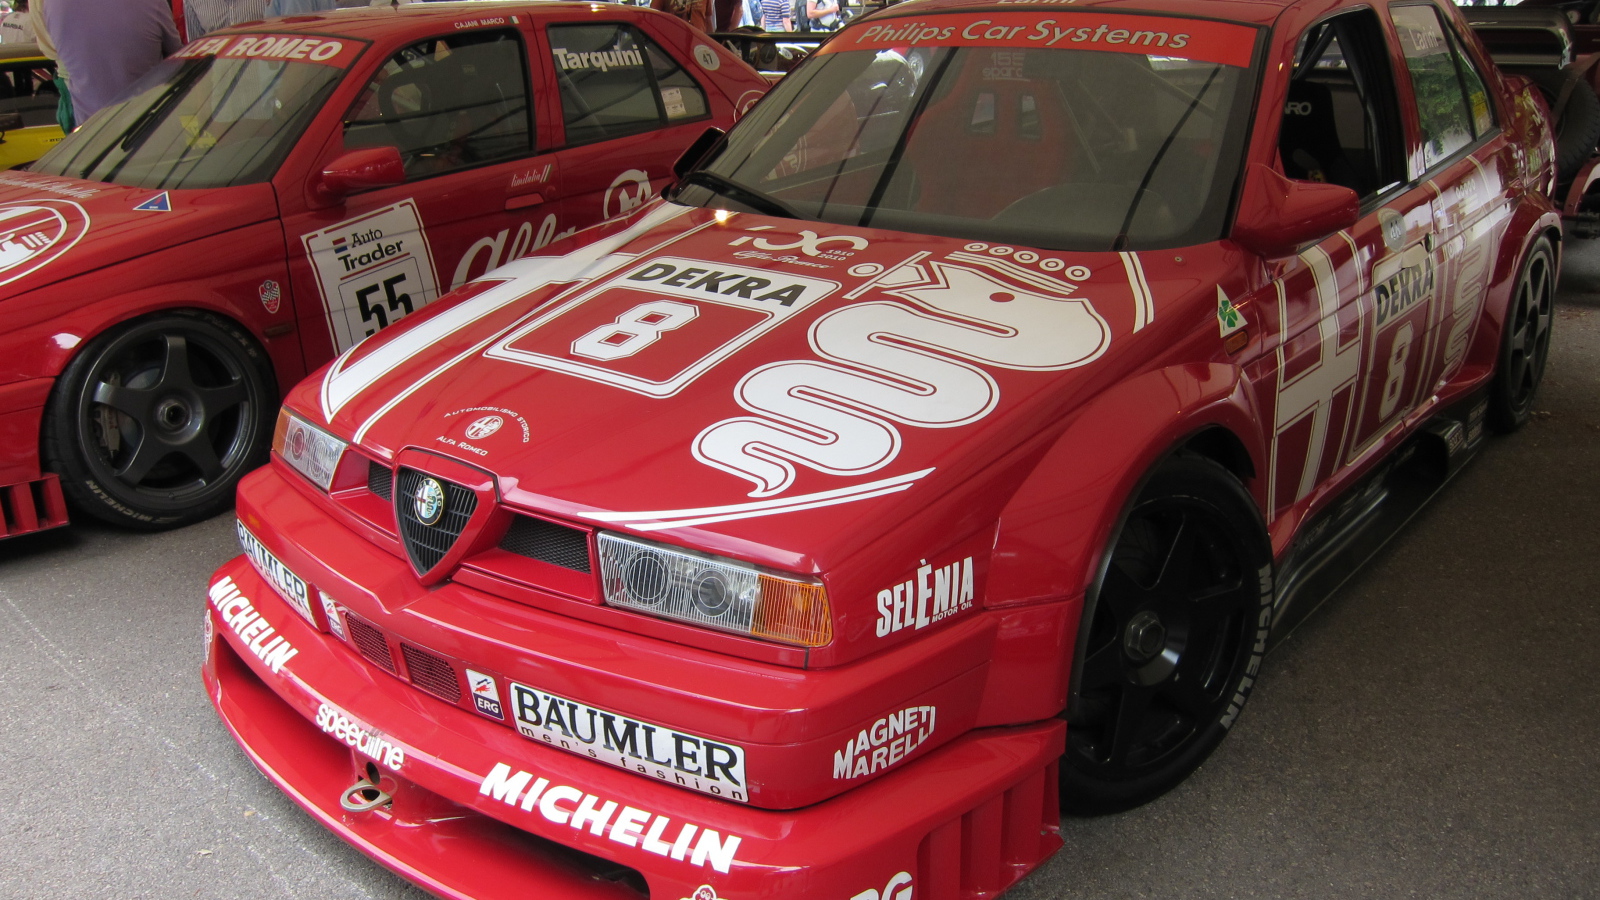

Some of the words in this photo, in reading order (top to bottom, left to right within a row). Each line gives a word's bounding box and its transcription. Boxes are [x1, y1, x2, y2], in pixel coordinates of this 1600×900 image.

[454, 20, 479, 29] CAJANI
[480, 17, 505, 26] MARCO
[856, 25, 956, 44] Philips
[961, 20, 1027, 40] Car
[1027, 20, 1192, 49] Systems
[1408, 25, 1439, 51] Larini
[174, 38, 230, 58] ALFA
[226, 37, 343, 61] ROMEO
[552, 45, 644, 72] Tarquini
[702, 54, 714, 66] 47
[338, 240, 403, 271] Trader
[351, 228, 383, 248] Auto
[817, 253, 847, 262] 2010
[626, 262, 807, 308] DEKRA
[1375, 257, 1434, 327] DEKRA
[355, 273, 414, 337] 55
[570, 300, 700, 361] 8
[1378, 321, 1413, 423] 8
[443, 406, 519, 419] AUTOMOBILISMO
[516, 416, 530, 443] STORICO
[435, 435, 457, 446] ALFA
[457, 441, 489, 457] ROMEO
[85, 480, 154, 522] MICHELIN
[876, 555, 974, 638] SELÈNIA
[931, 606, 958, 623] MOTOR
[960, 600, 973, 611] OIL
[208, 575, 299, 674] MICHELIN
[1207, 562, 1274, 730] MICHELIN
[477, 697, 500, 715] ERG
[513, 684, 744, 788] BÄUMLER
[832, 705, 936, 767] MAGNETI
[619, 756, 743, 801] fashion
[479, 762, 742, 874] MICHELIN
